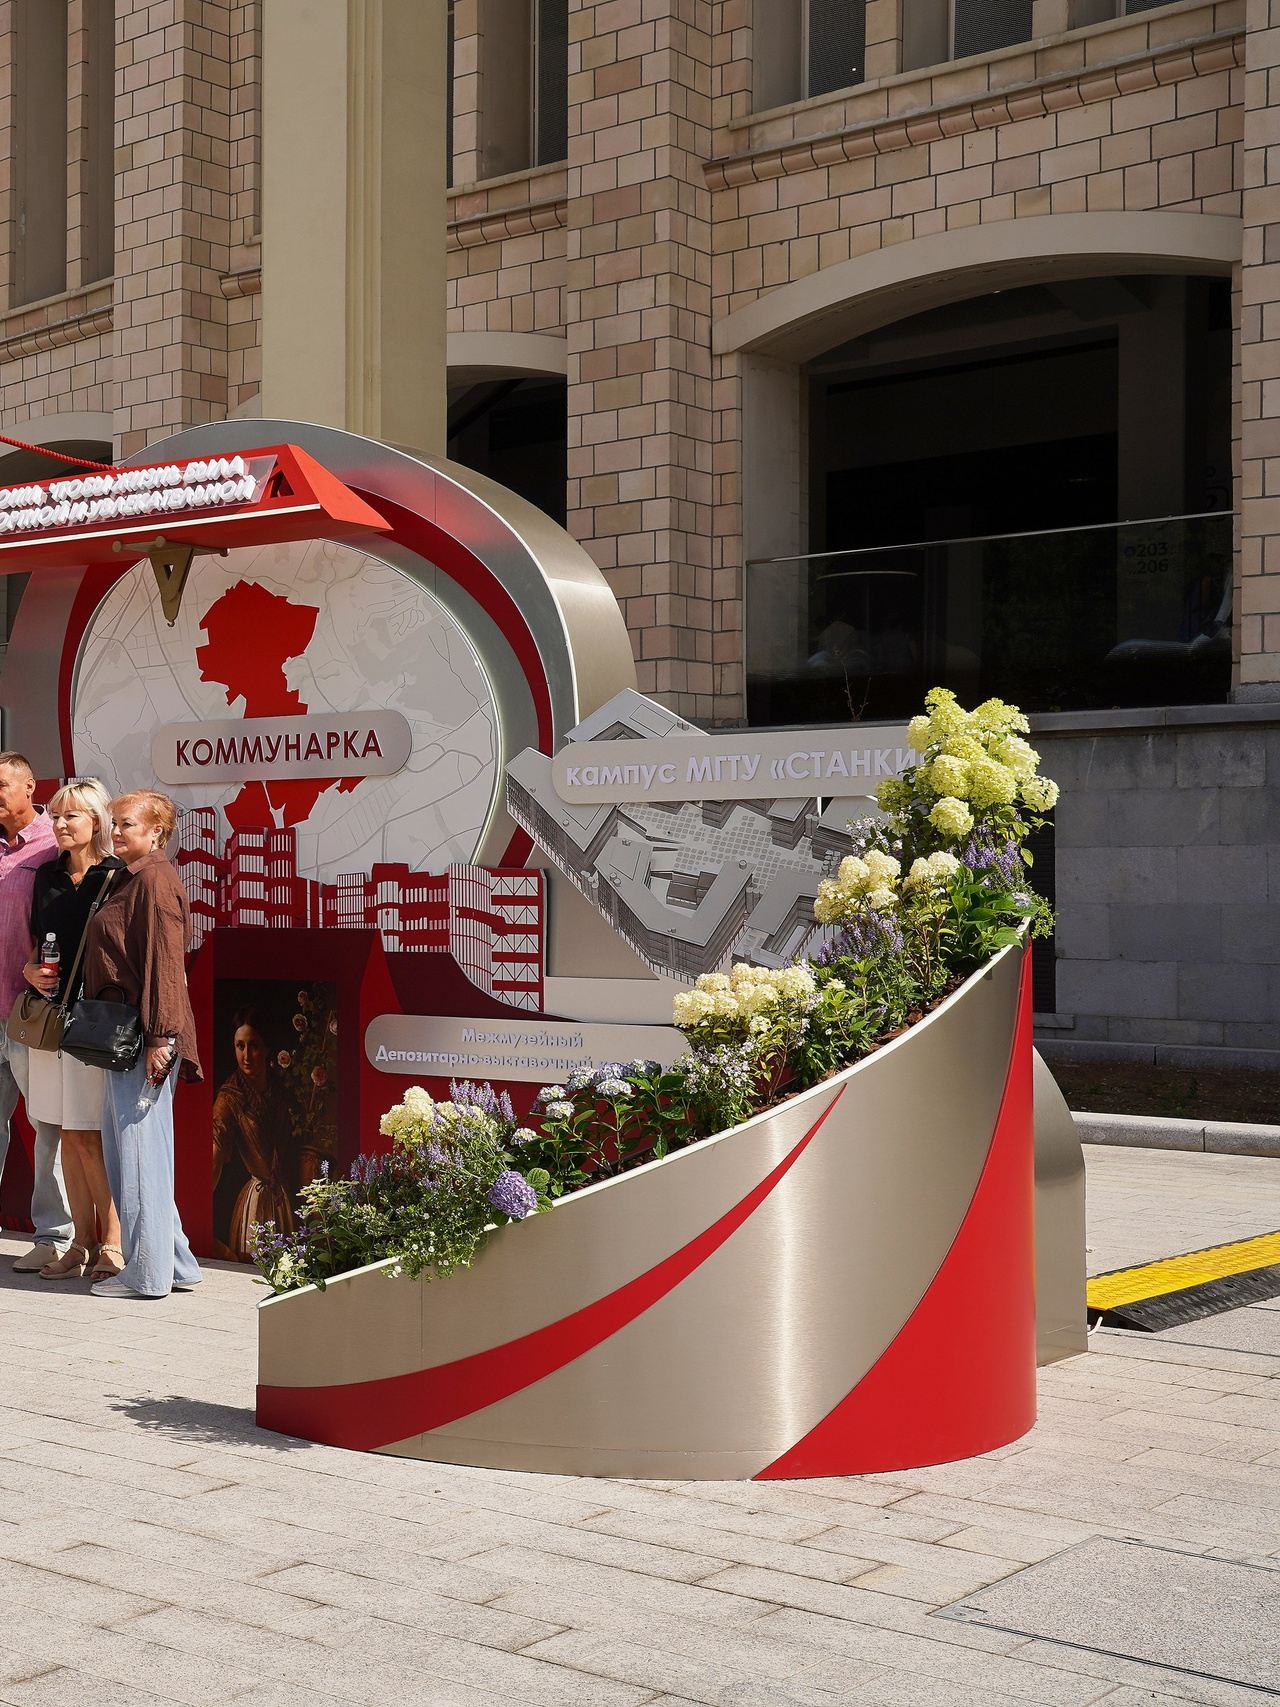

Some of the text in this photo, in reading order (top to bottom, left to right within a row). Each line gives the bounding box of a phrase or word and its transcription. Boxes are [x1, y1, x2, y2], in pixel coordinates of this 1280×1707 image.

[49, 475, 114, 502] ЧТОБЫ
[111, 465, 182, 494] ЖИЗНЬ
[183, 455, 244, 484] БЫЛА
[69, 501, 89, 522] И
[86, 475, 256, 521] УВЛЕКАТЕЛЬНОЙ
[176, 729, 384, 766] КОММУНАРКА
[566, 748, 926, 790] кампус МГТУ «СТАНКИ
[375, 1045, 593, 1070] Депозитарно-выставочный
[461, 1028, 583, 1048] Межмузейный
